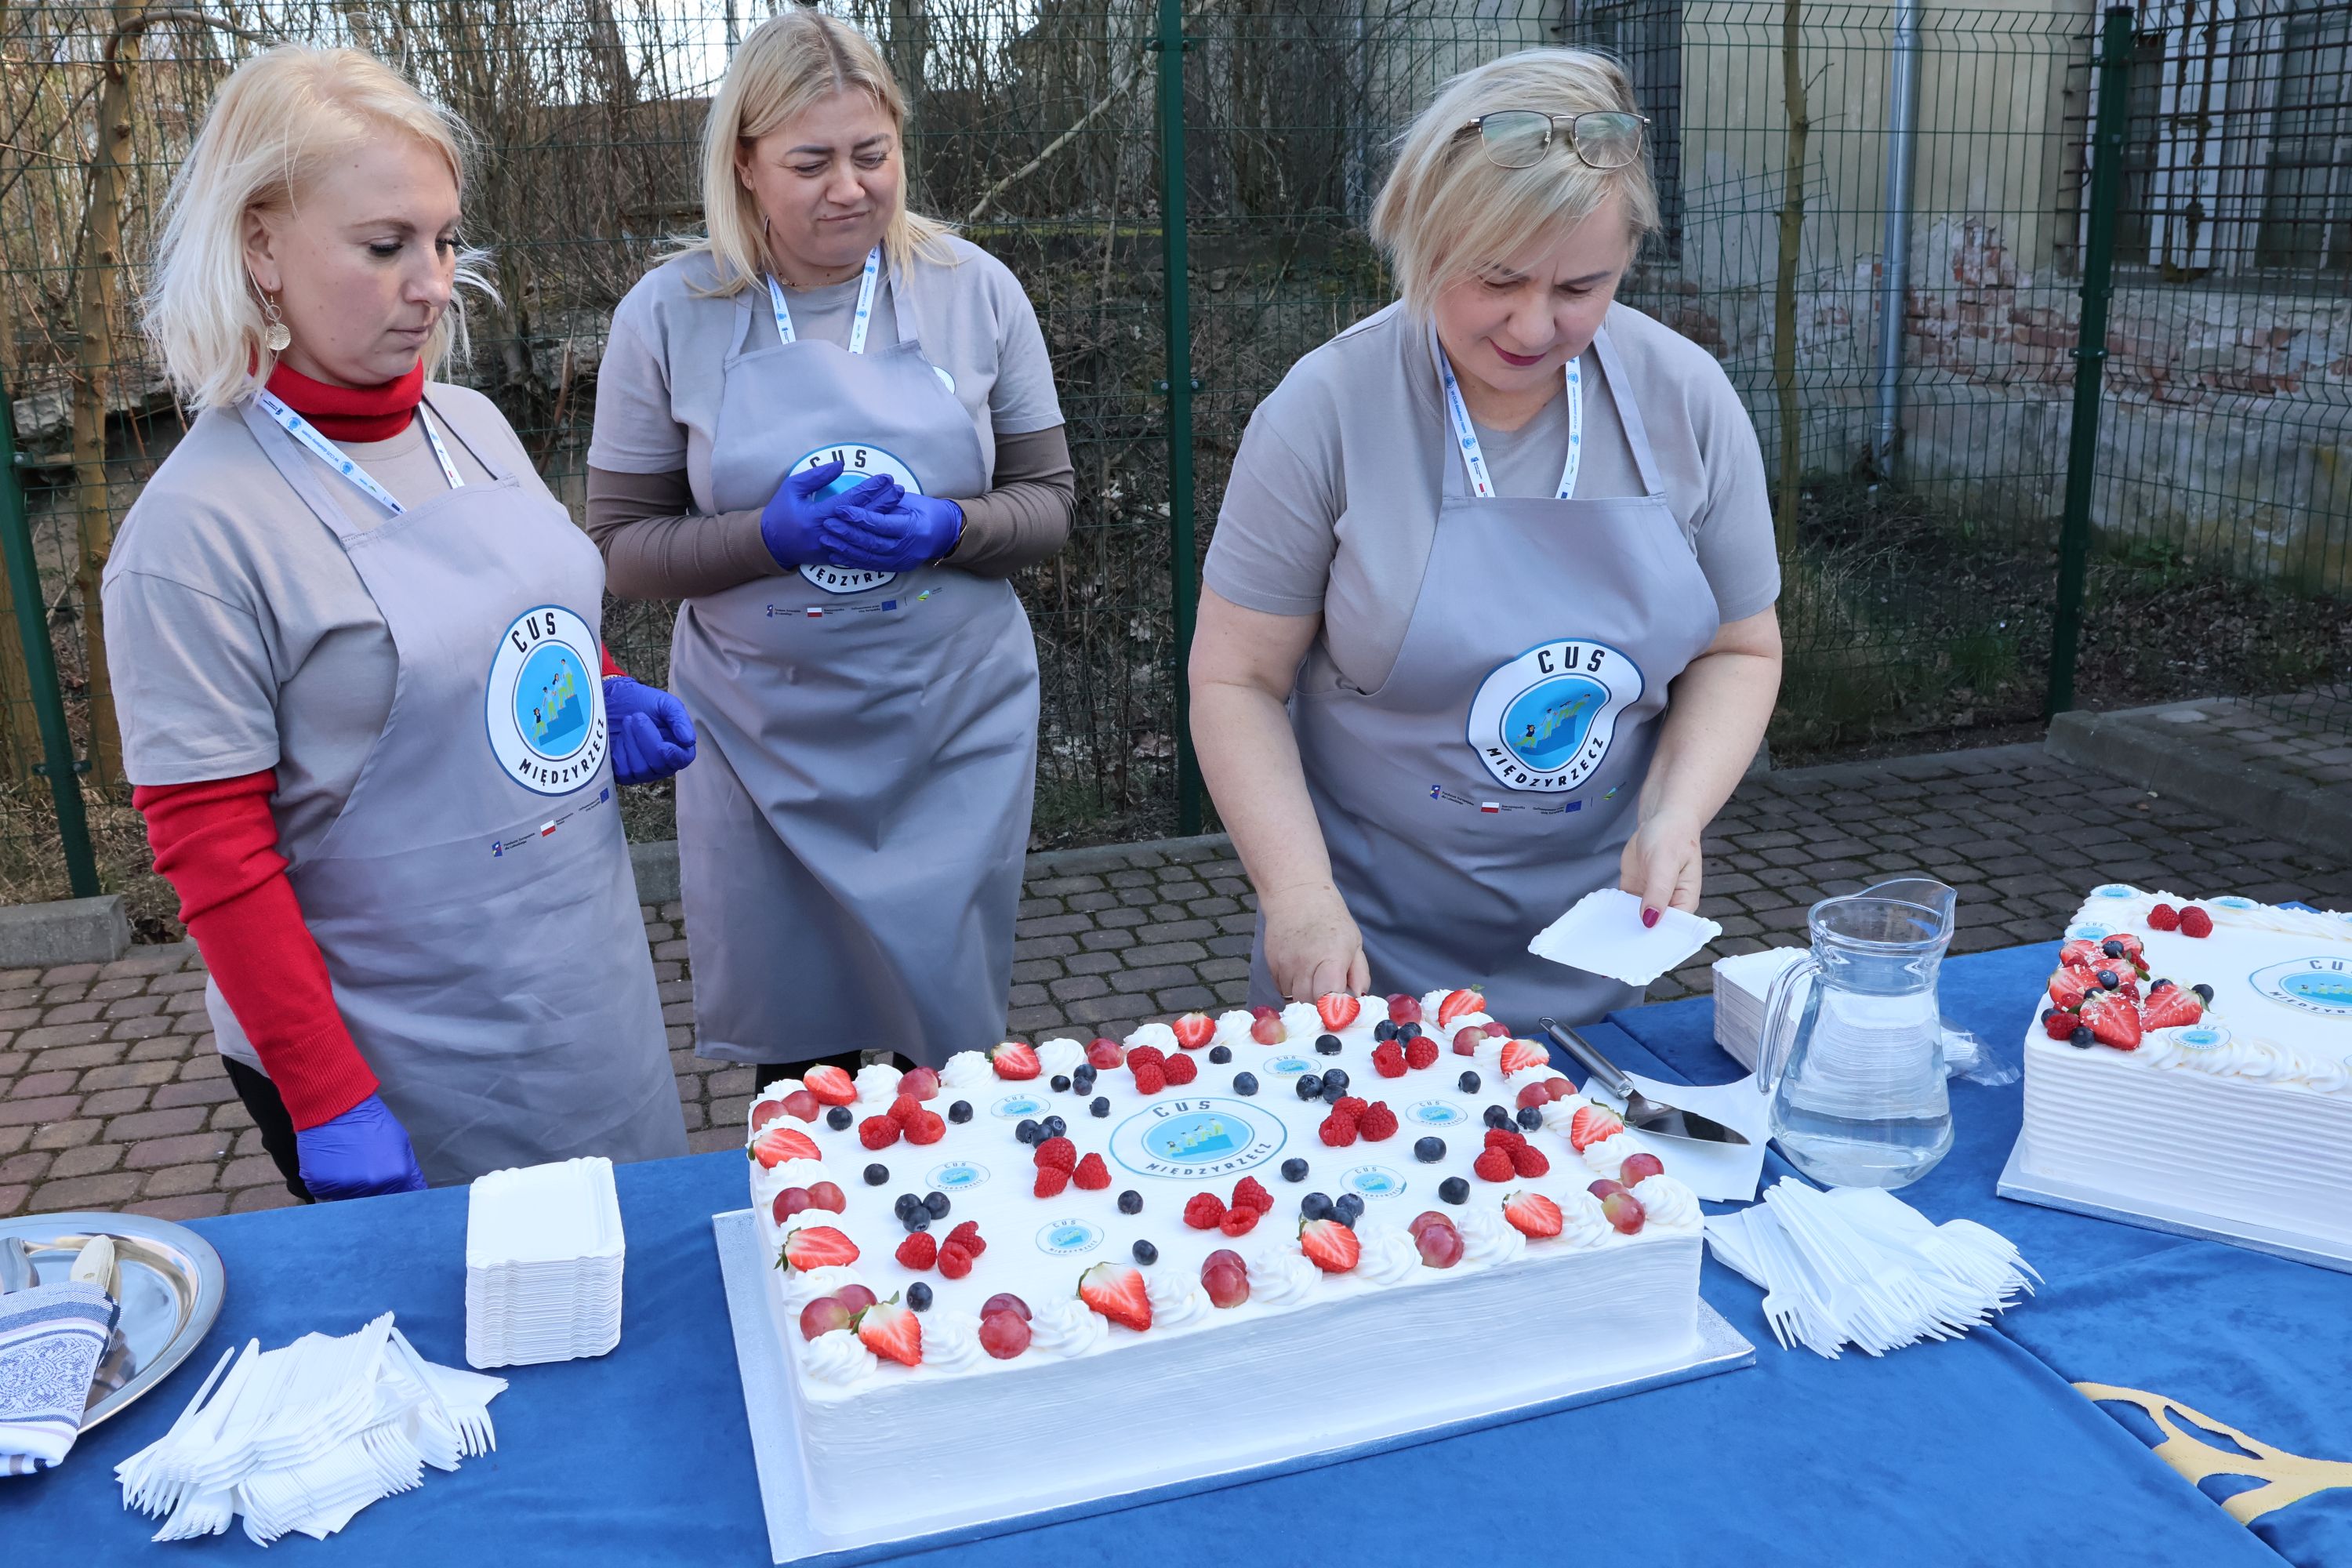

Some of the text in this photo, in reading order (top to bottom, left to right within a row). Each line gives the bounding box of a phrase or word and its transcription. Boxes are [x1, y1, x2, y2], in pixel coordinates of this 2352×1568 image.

[511, 612, 557, 653] CUS
[1537, 646, 1606, 674] CUS
[518, 717, 604, 786] MIĘDZYRZECZ
[1486, 737, 1605, 788] MIĘDZYRZECZ
[1152, 1100, 1210, 1118] CUS
[1145, 1142, 1272, 1176] MIĘDZYRZECZ
[1052, 1219, 1076, 1229] CUS
